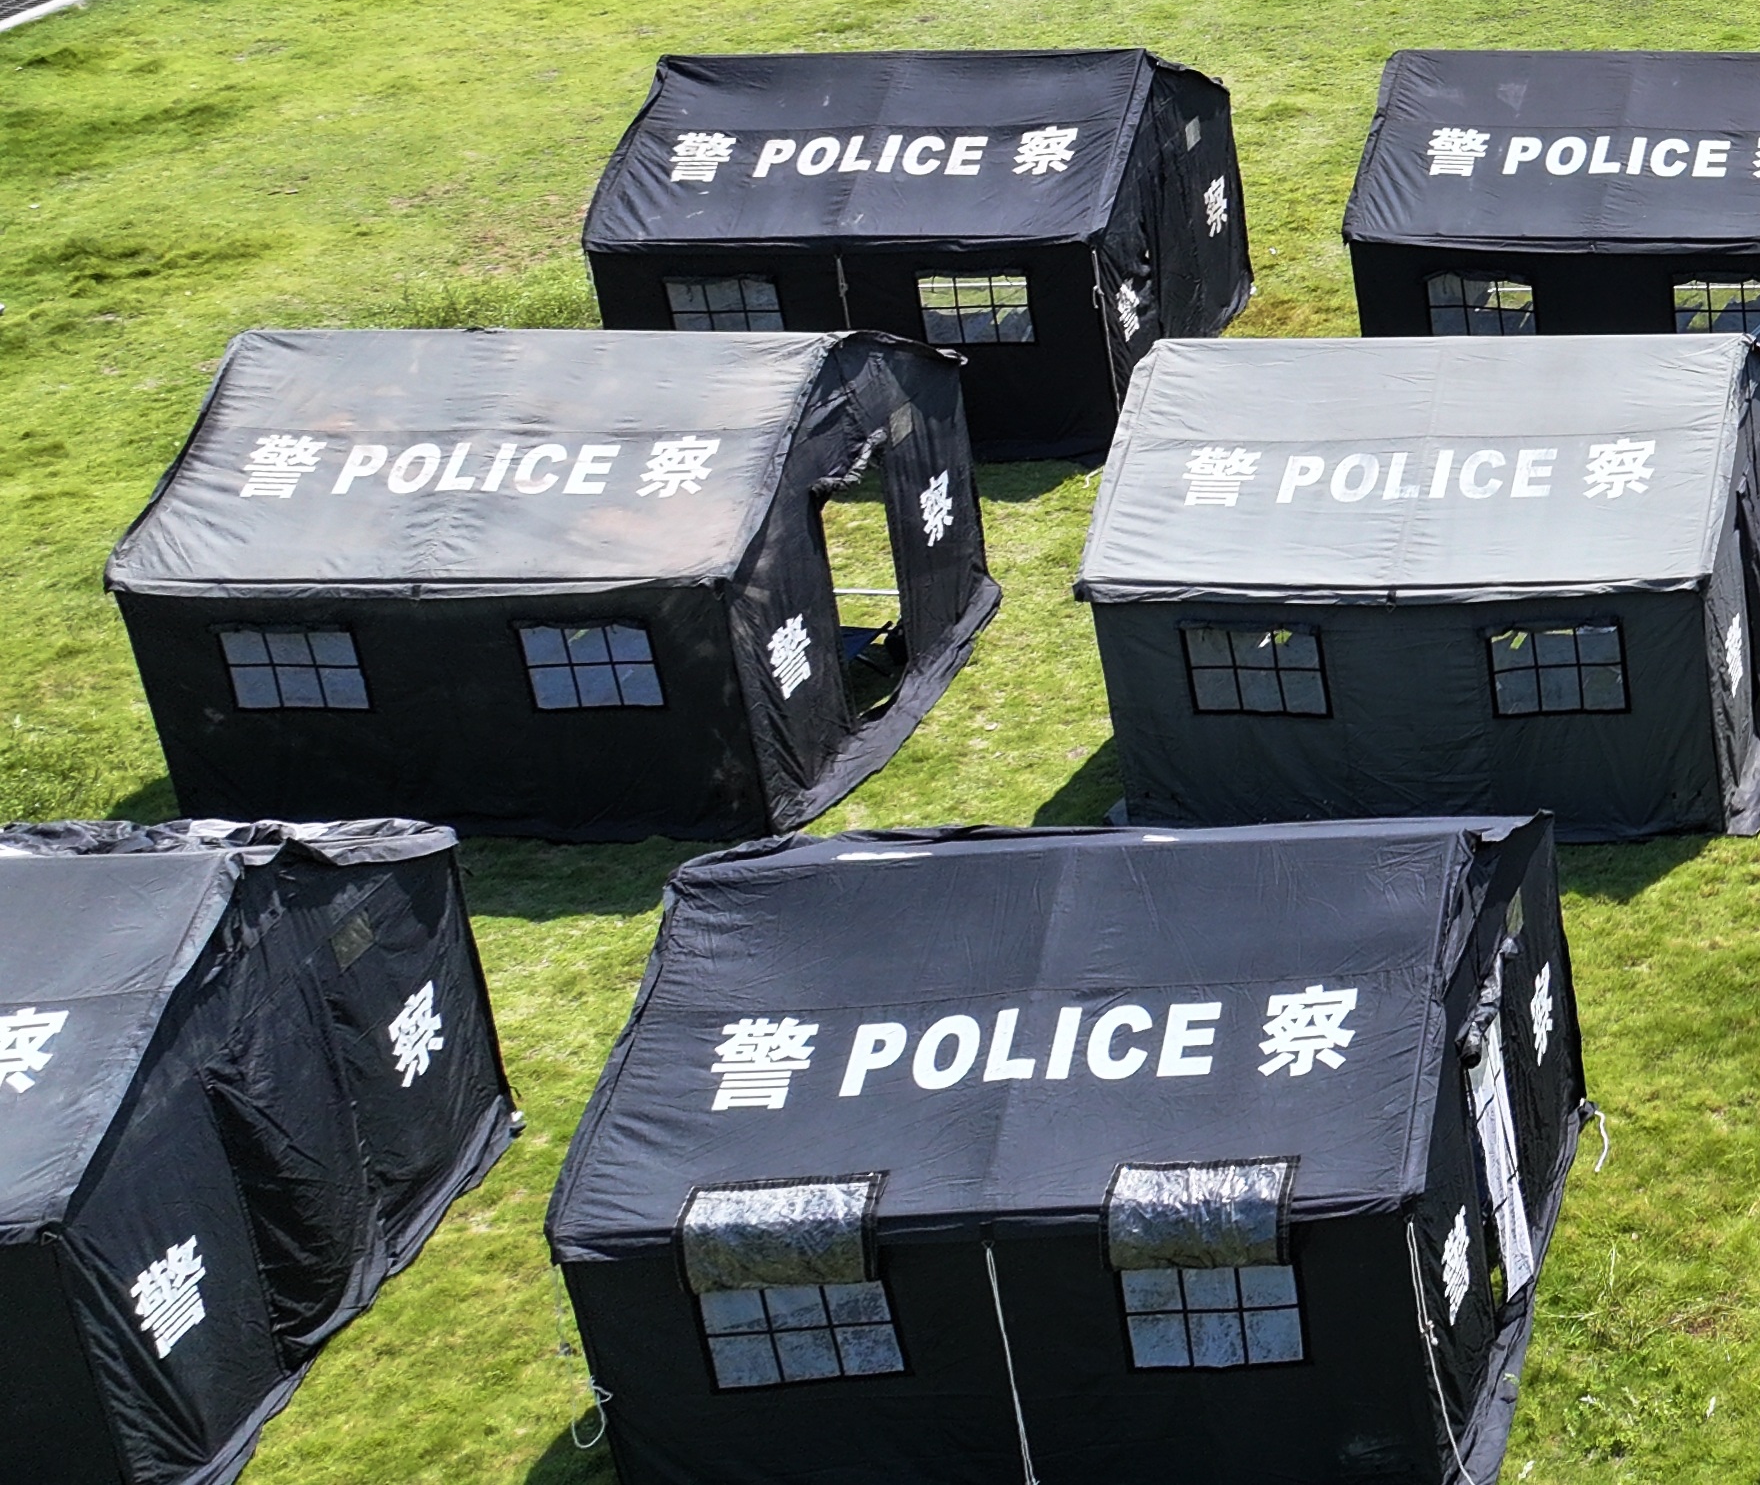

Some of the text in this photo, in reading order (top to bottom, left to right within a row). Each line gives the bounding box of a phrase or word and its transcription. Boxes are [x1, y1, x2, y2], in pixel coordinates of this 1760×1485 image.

[670, 126, 1078, 182] 警 POLICE 察
[1427, 128, 1490, 176] 警
[1503, 136, 1730, 177] POLICE
[240, 435, 720, 498] 警 POLICE 察
[1182, 439, 1655, 506] 警 POLICE 察
[767, 470, 953, 699] 警 察
[711, 985, 1357, 1110] 警 POLICE 察
[130, 981, 444, 1358] 警 察
